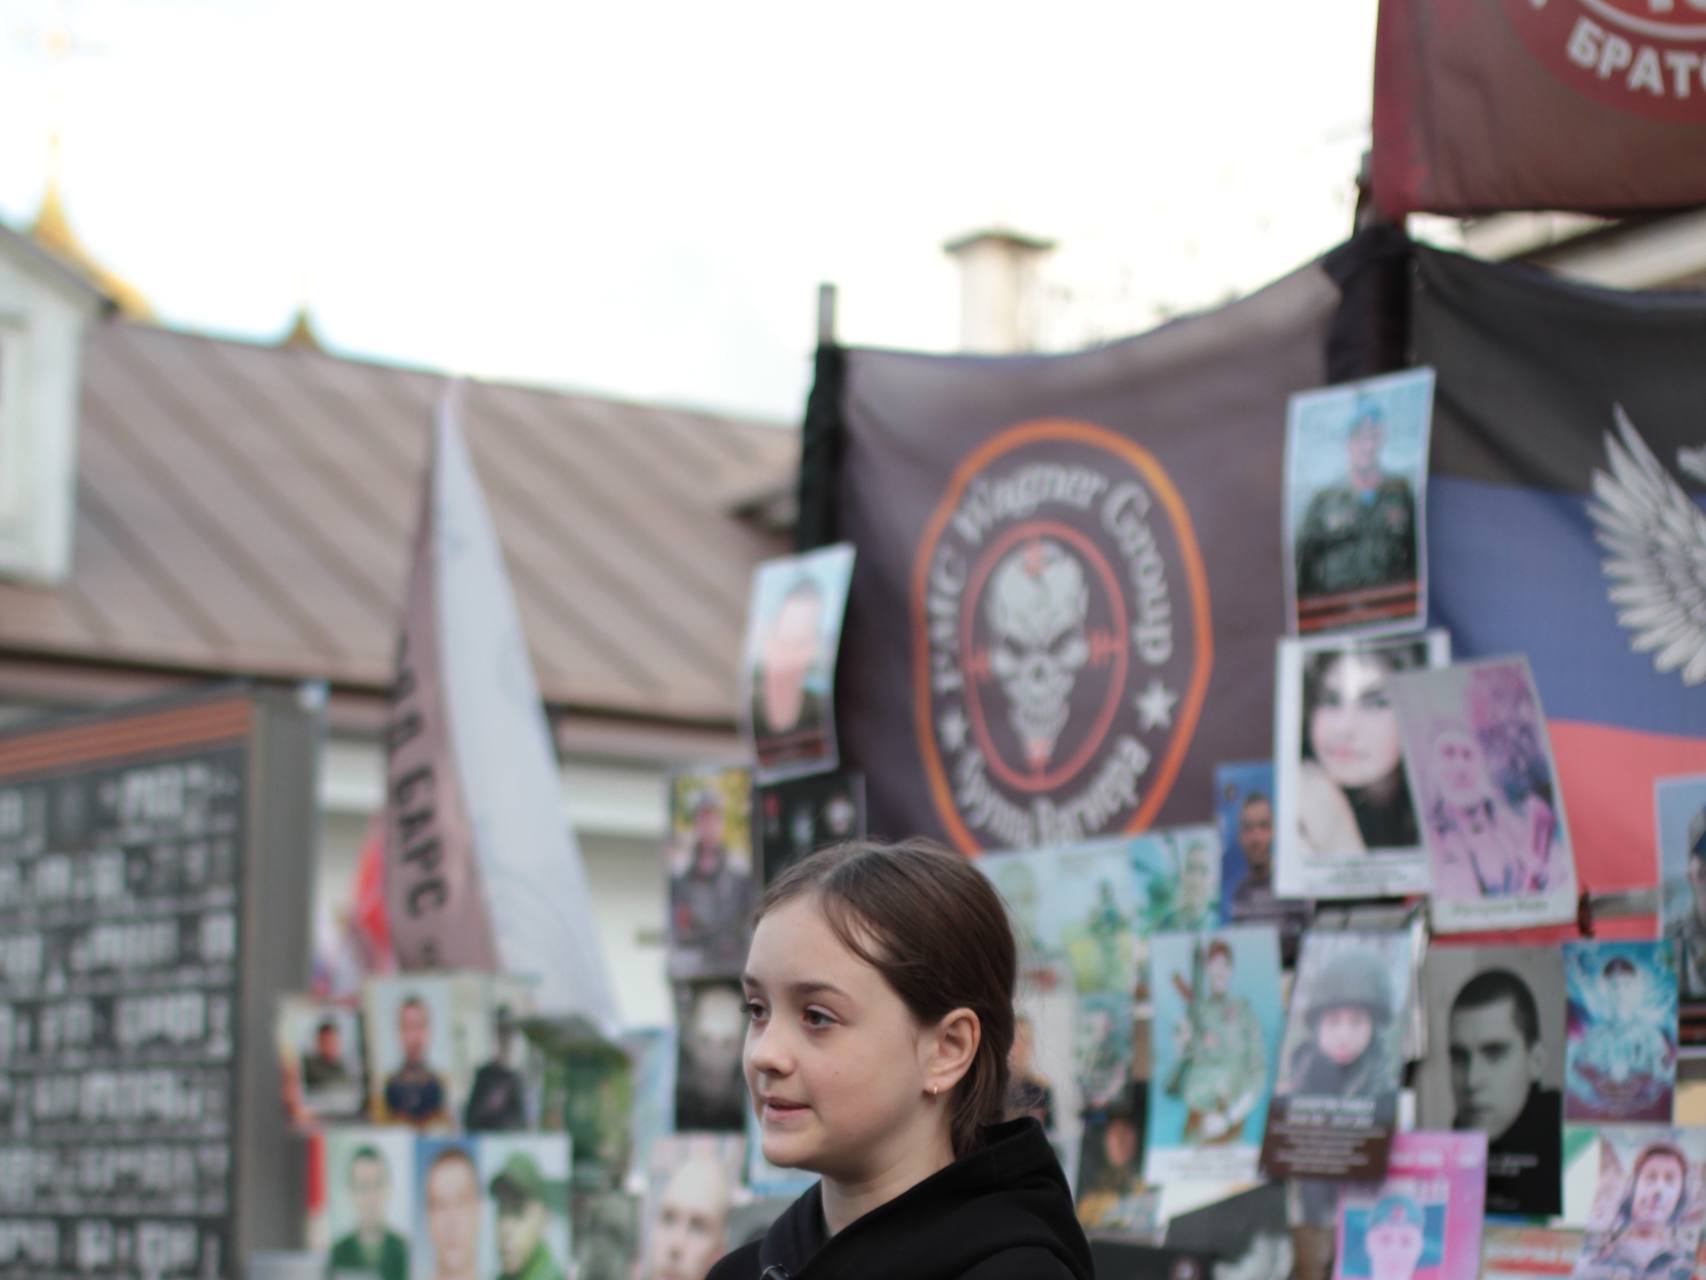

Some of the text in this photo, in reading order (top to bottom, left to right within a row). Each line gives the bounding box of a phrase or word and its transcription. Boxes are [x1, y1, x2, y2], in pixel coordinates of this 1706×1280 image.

[1567, 16, 1706, 97] БРАТ
[953, 463, 1108, 544] Wagner
[1101, 480, 1173, 665] Group
